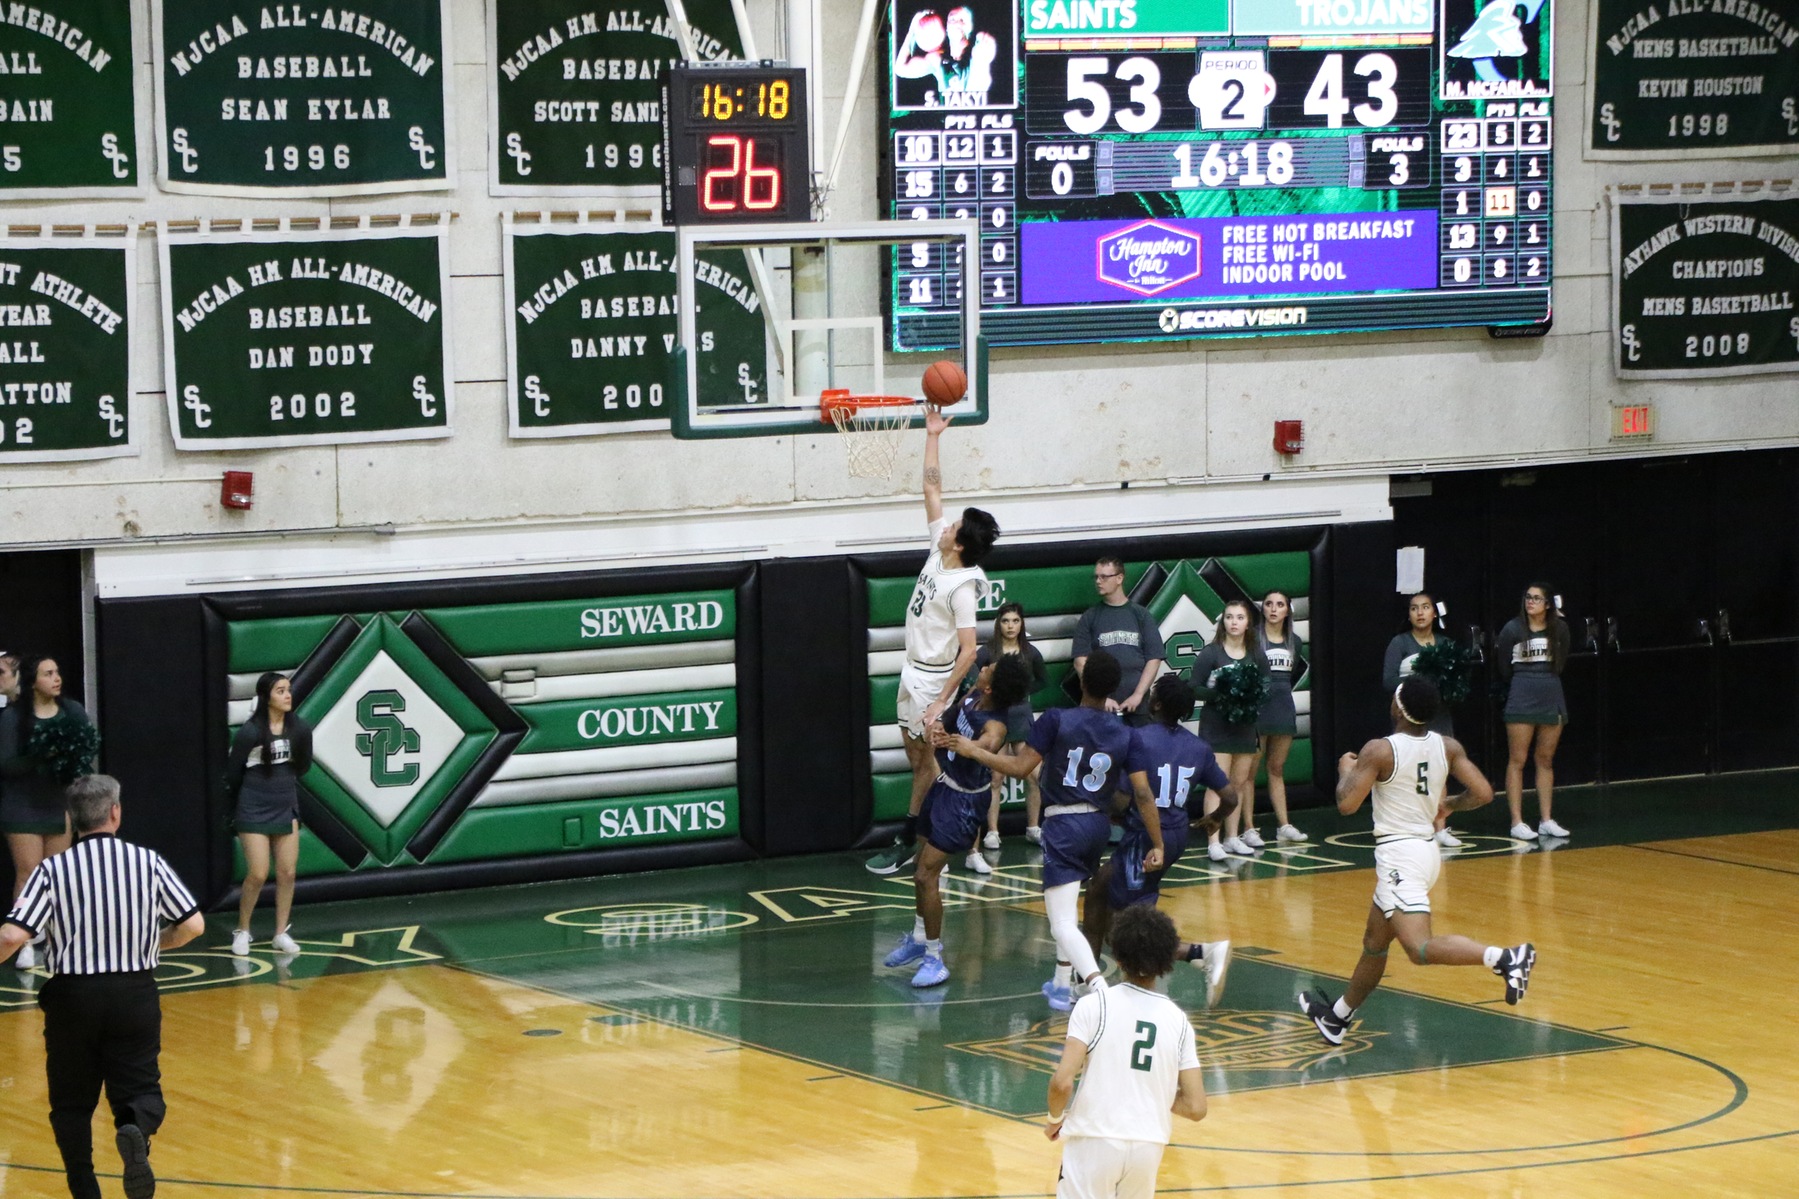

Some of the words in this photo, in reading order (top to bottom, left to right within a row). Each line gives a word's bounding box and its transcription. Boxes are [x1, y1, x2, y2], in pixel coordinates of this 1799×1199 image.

[1031, 0, 1137, 29] SAINTS
[1297, 0, 1429, 26] TROJANS
[170, 15, 249, 77] NJCAA
[260, 5, 435, 77] ALL-AMERICAN
[1606, 5, 1661, 56] NJCAA
[500, 28, 562, 81] NJCAA
[1633, 39, 1674, 58] MENS
[1679, 36, 1779, 57] BASKETBALL
[238, 56, 372, 79] BASEBALL
[1205, 59, 1257, 71] PERIOD
[703, 80, 789, 120] 16:18
[1063, 56, 1162, 134] 53
[1221, 79, 1245, 120] 2
[1303, 53, 1398, 128] 43
[1638, 79, 1688, 98] KEVIN
[1693, 76, 1764, 97] HOUSTON
[221, 99, 288, 121] SEAN
[308, 98, 391, 120] EYLAR
[535, 101, 599, 122] SCOTT
[1448, 123, 1478, 149] 23
[1495, 124, 1508, 144] 5
[1528, 123, 1542, 143] 2
[1669, 113, 1728, 137] 1998
[905, 136, 933, 162] 10
[948, 137, 974, 158] 12
[991, 136, 1006, 157] 1
[1035, 145, 1090, 161] FOULS
[1371, 136, 1424, 153] FOULS
[264, 145, 351, 171] 1996
[1172, 142, 1294, 188] 16:18
[1388, 153, 1409, 185] 3
[1455, 157, 1472, 182] 3
[1494, 158, 1508, 178] 4
[1527, 157, 1541, 177] 1
[703, 135, 780, 211] 26
[905, 171, 934, 198] 15
[954, 173, 969, 193] 6
[992, 172, 1006, 193] 2
[1051, 162, 1073, 195] 0
[1455, 191, 1469, 215] 1
[1490, 194, 1510, 211] 11
[1528, 191, 1541, 211] 0
[992, 208, 1006, 228] 0
[1684, 214, 1756, 238] WESTERN
[1223, 225, 1268, 243] FREE
[1273, 224, 1308, 242] HOT
[1313, 220, 1415, 241] BREAKFAST
[1449, 225, 1476, 249] 13
[1494, 225, 1507, 245] 9
[1527, 223, 1541, 243] 1
[992, 242, 1006, 262] 0
[1109, 236, 1192, 262] Hampton
[1223, 245, 1268, 264] FREE
[1272, 244, 1320, 262] WI-FI
[1128, 255, 1169, 278] Inn
[1223, 264, 1293, 284] INDOOR
[1299, 262, 1346, 281] POOL
[1454, 258, 1470, 282] 0
[1527, 257, 1540, 277] 2
[1673, 258, 1765, 279] CHAMPIONS
[176, 276, 244, 333] NJCAA
[290, 258, 438, 323] ALL-AMERICAN
[517, 269, 579, 324] NJCAA
[993, 277, 1007, 297] 1
[30, 271, 123, 335] ATHLETE
[1642, 297, 1685, 316] MENS
[1691, 291, 1794, 316] BASKETBALL
[249, 304, 372, 330] BASEBALL
[249, 346, 295, 369] DAN
[309, 343, 375, 367] DODY
[571, 335, 647, 359] DANNY
[1686, 333, 1751, 358] 2008
[270, 391, 357, 421] 2002
[581, 601, 723, 638] SEWARD
[577, 700, 724, 739] COUNTY
[355, 688, 421, 788] SC
[1063, 746, 1112, 792] 13
[1415, 762, 1429, 796] 5
[1154, 763, 1196, 809] 15
[600, 800, 726, 839] SAINTS
[1129, 1020, 1157, 1072] 2
